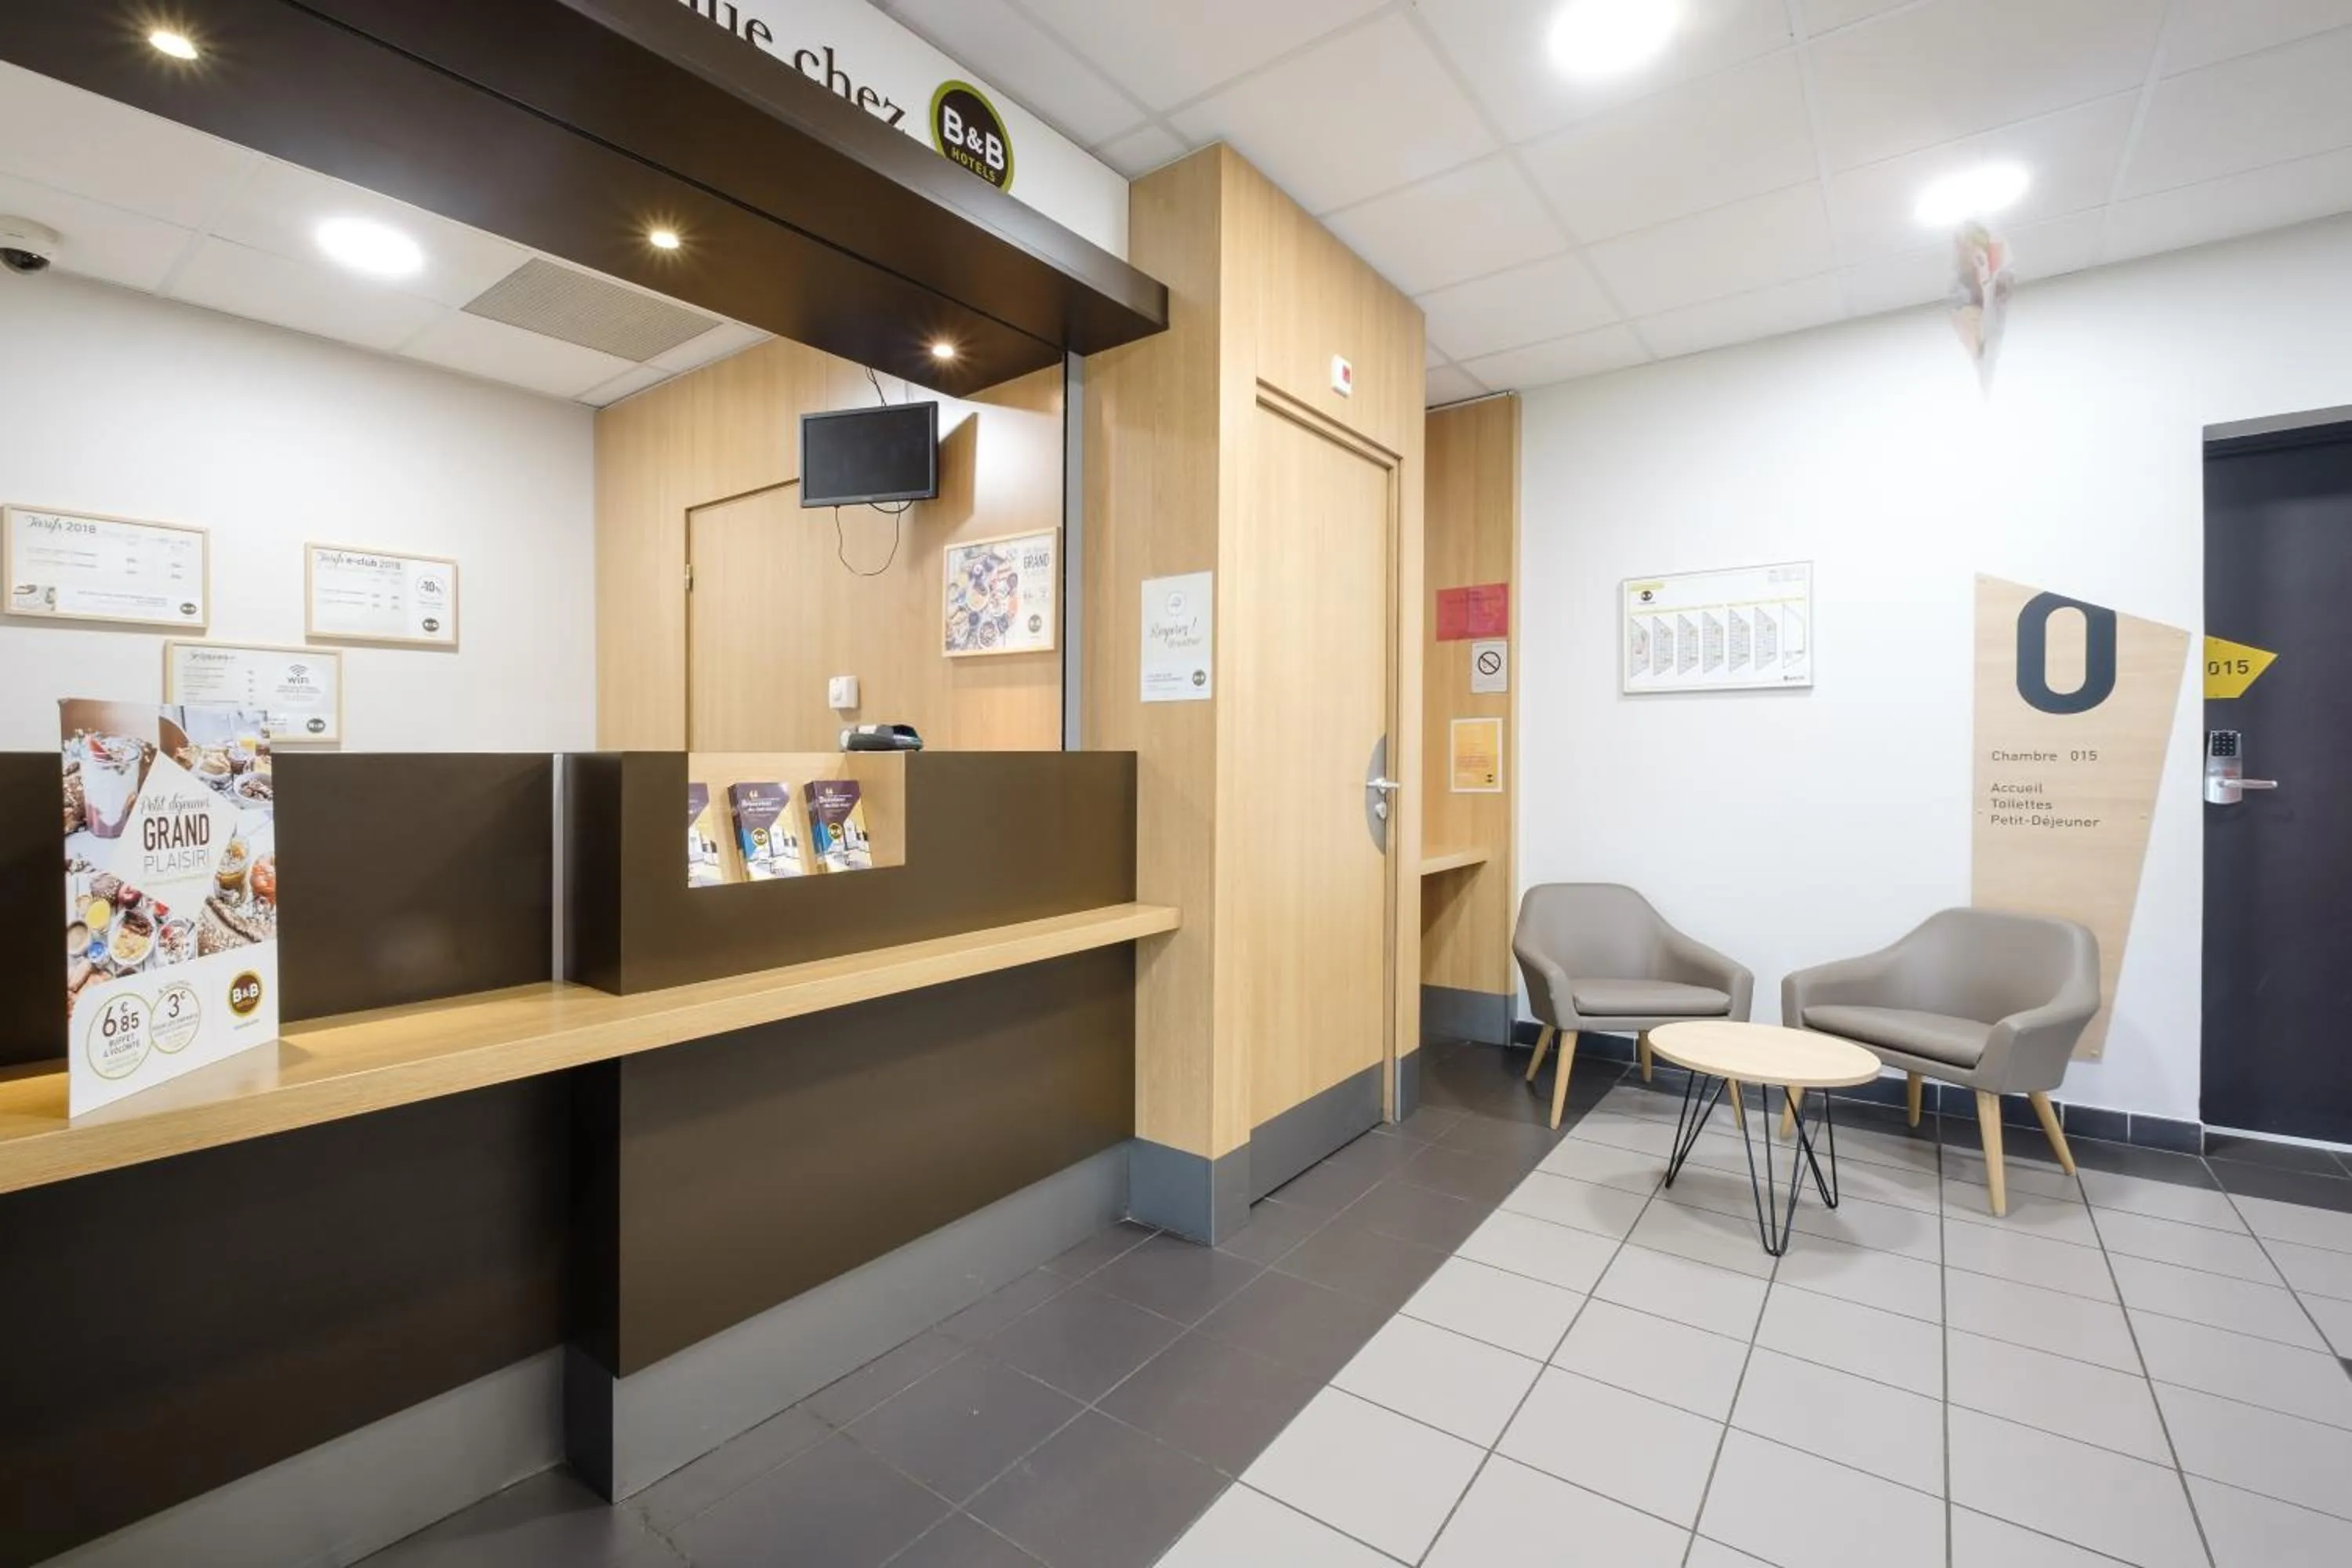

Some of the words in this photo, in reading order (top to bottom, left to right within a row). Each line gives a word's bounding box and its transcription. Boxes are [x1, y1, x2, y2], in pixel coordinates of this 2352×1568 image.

[943, 105, 1004, 171] B&B
[952, 147, 996, 183] HOTELS
[66, 522, 97, 535] 2018
[2207, 659, 2250, 676] 015
[1991, 750, 2057, 762] Chambre
[2071, 750, 2098, 761] 015
[1991, 783, 2043, 794] Accueil
[1991, 799, 2053, 811] Toilettes
[143, 813, 209, 851] GRAND
[233, 983, 258, 1004] B&B
